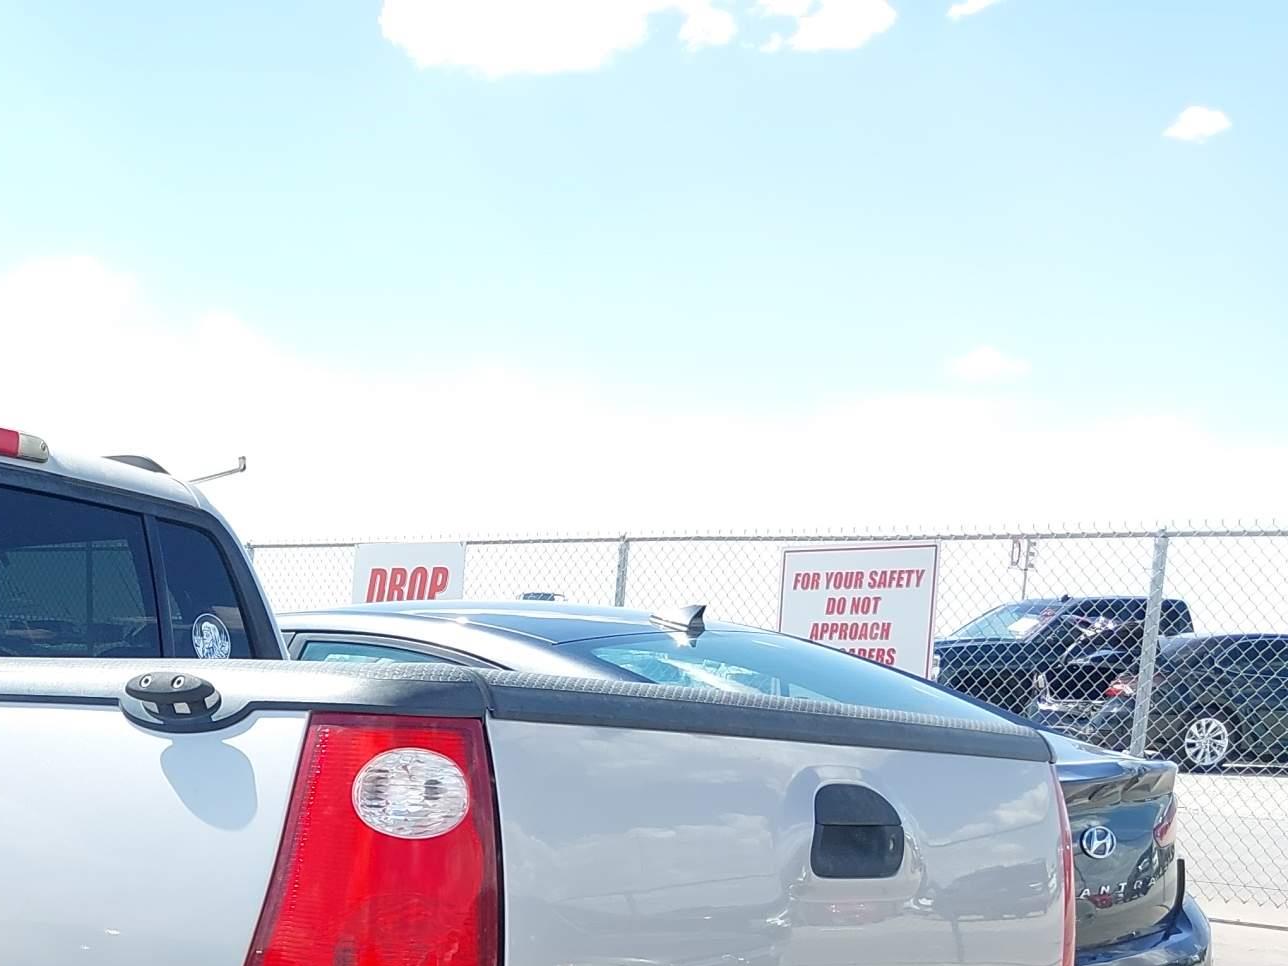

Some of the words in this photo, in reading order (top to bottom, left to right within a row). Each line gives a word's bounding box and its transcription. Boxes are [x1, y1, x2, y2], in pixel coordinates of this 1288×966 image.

[366, 566, 449, 603] DROP
[793, 573, 821, 590] FOR
[825, 571, 864, 590] YOUR
[868, 569, 925, 589] SAFETY
[826, 598, 846, 615] DO
[850, 597, 881, 614] NOT
[810, 622, 892, 640] APPROACH
